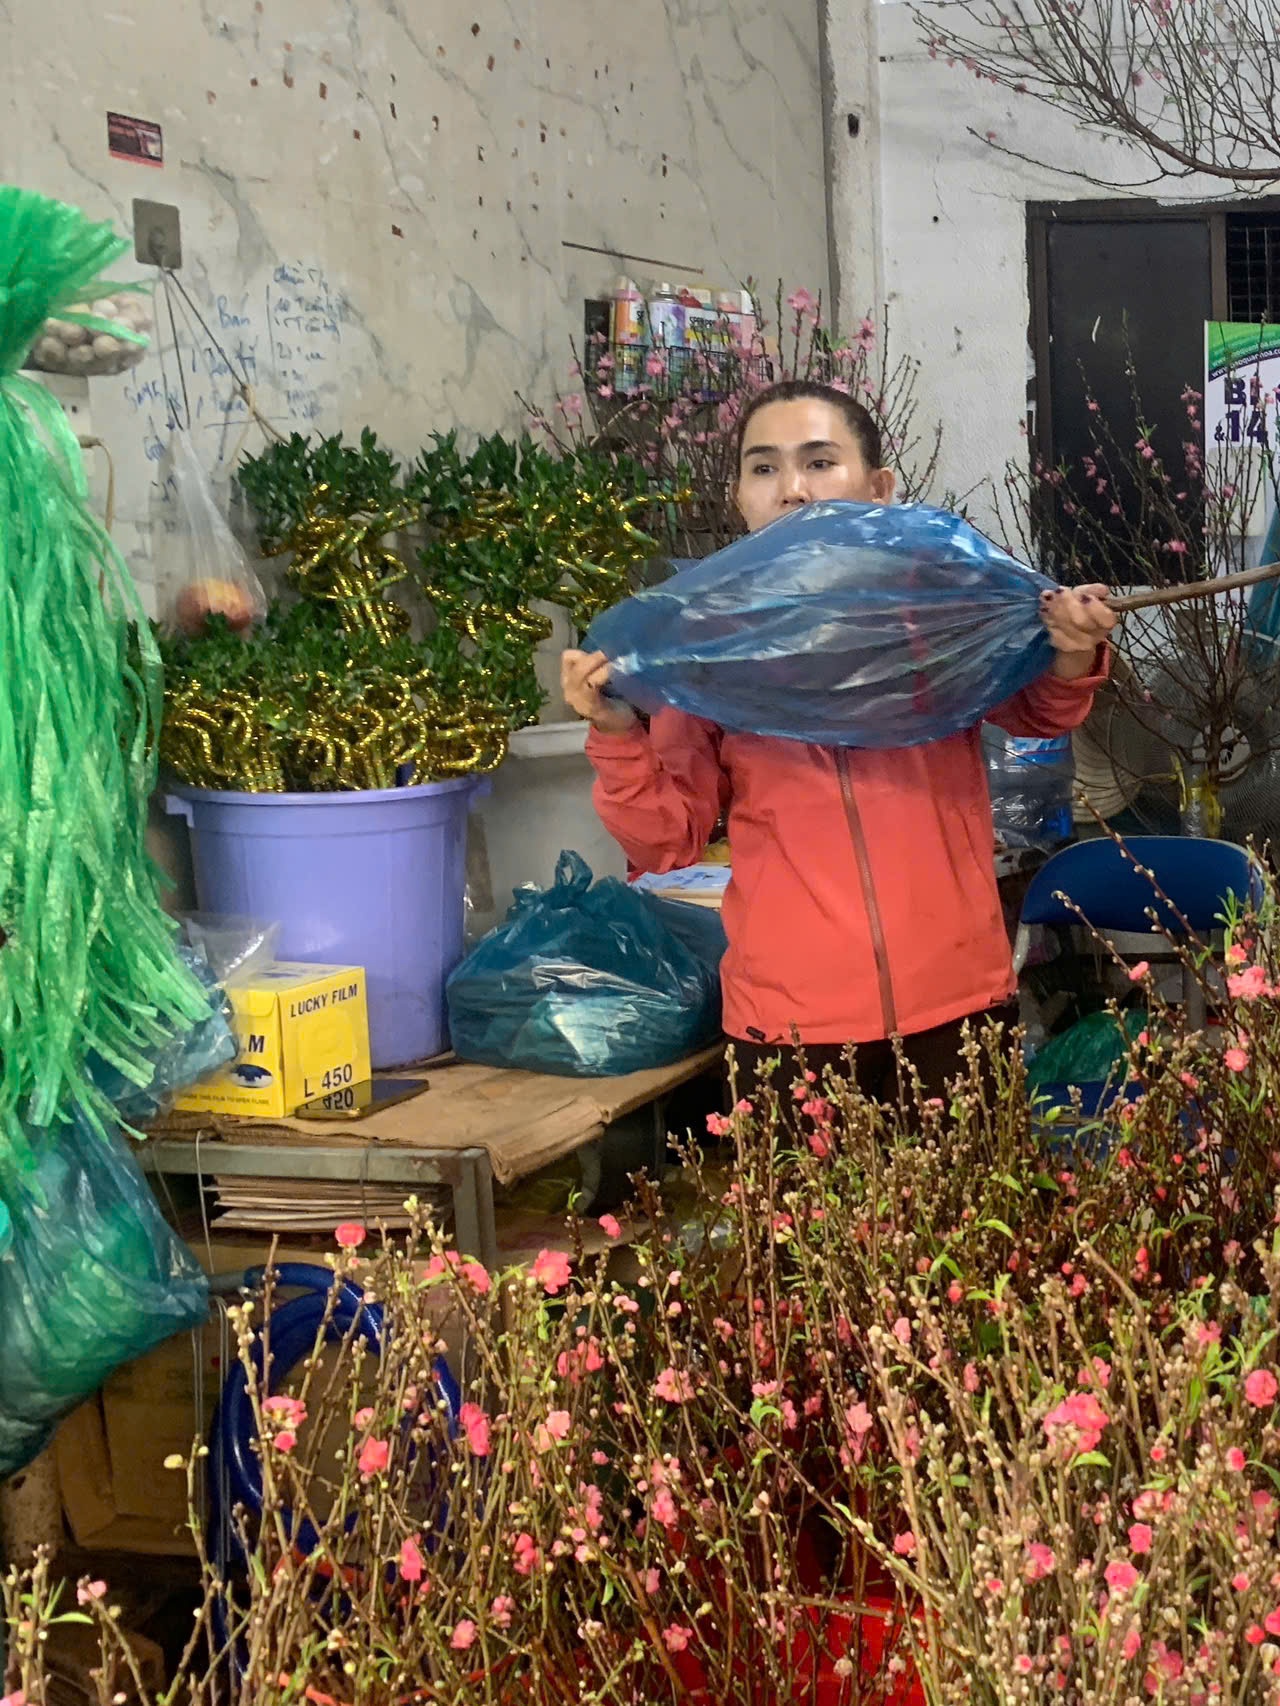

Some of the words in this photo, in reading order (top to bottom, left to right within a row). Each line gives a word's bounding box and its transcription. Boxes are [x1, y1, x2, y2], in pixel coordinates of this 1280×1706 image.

[290, 993, 328, 1018] LUCKY
[331, 983, 358, 1004] FILM
[304, 1078, 315, 1098] L
[321, 1063, 352, 1089] 450
